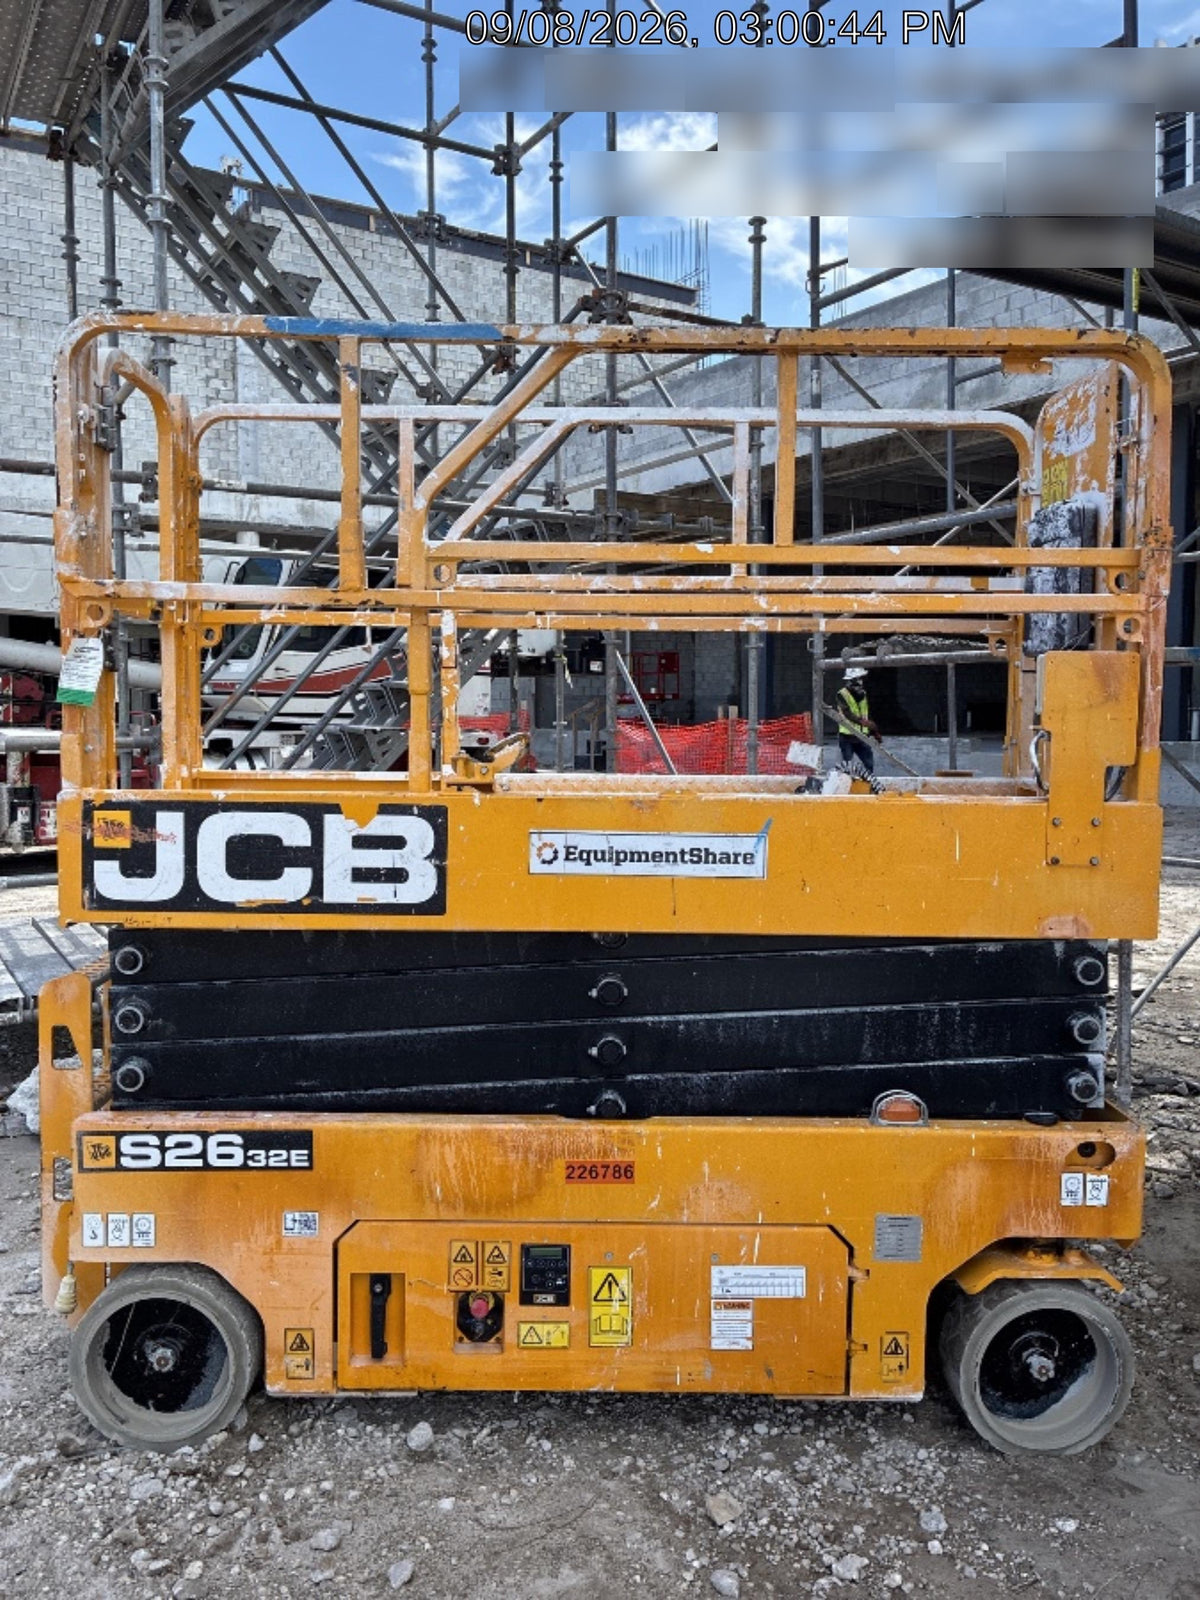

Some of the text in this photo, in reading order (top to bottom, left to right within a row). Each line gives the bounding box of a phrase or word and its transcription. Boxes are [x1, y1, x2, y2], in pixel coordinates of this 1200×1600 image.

[93, 810, 438, 904] JCB
[563, 845, 756, 866] EquipmentShare
[119, 1133, 245, 1168] S26
[246, 1149, 310, 1168] 32E
[565, 1163, 634, 1180] 226786
